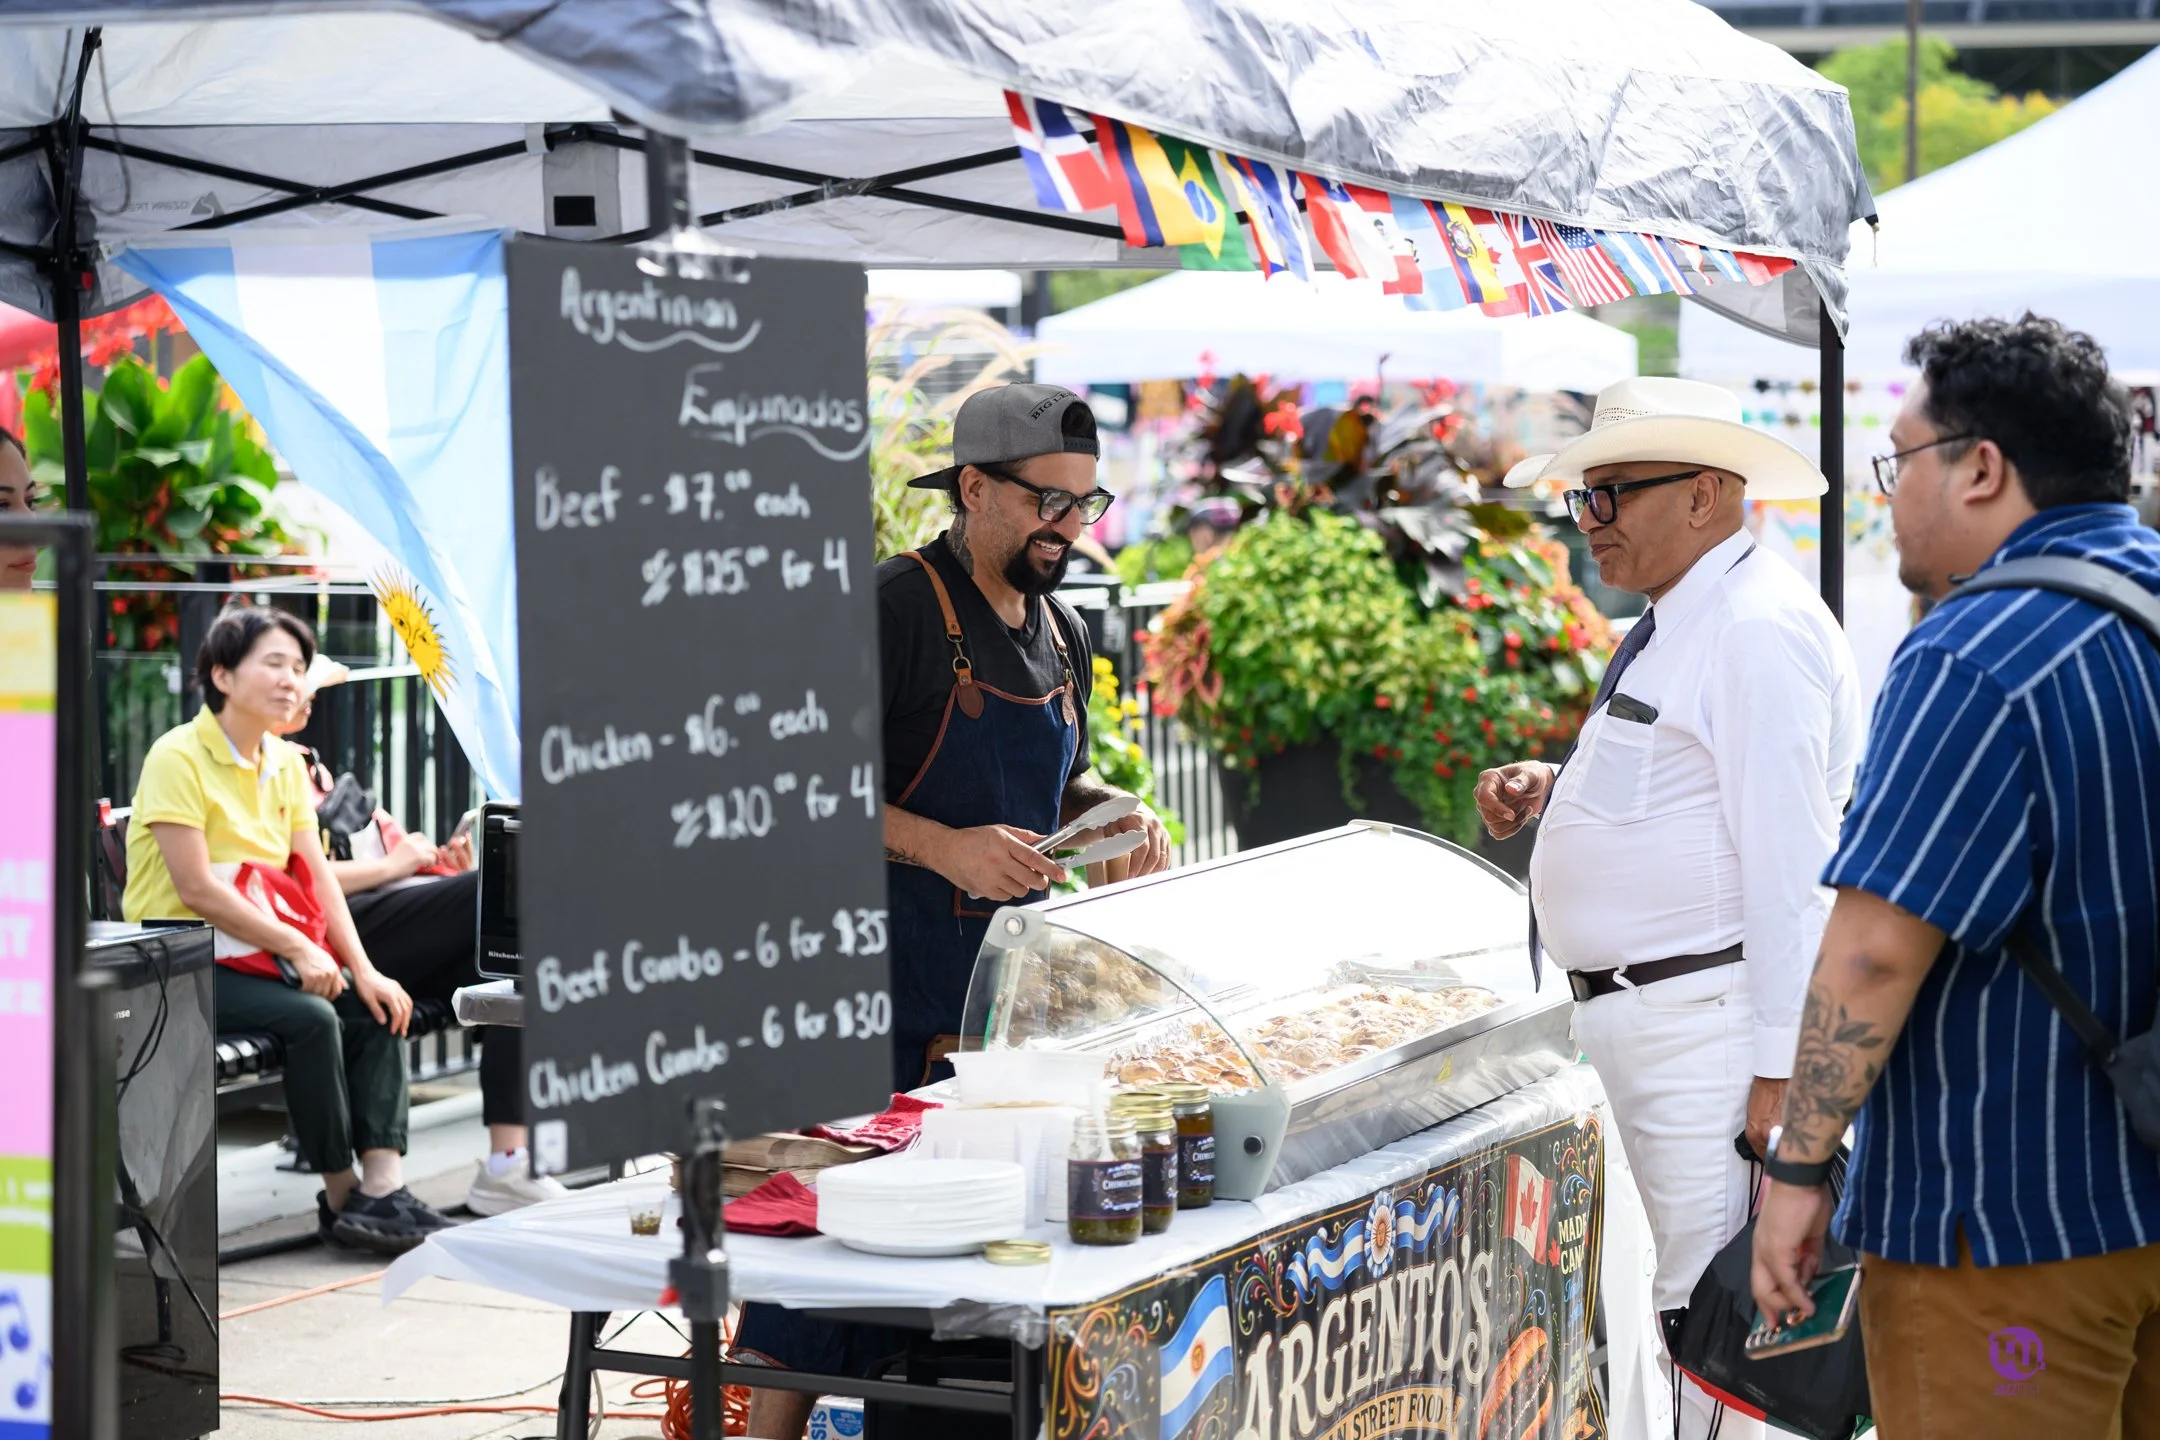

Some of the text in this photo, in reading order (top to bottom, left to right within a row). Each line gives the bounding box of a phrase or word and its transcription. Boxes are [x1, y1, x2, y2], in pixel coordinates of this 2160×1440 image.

[1031, 401, 1053, 421] BIG
[534, 464, 622, 531] Beef
[754, 483, 811, 519] each
[781, 549, 814, 590] for
[823, 537, 850, 594] 4
[540, 725, 653, 785] Chicken
[769, 688, 829, 740] each
[805, 774, 840, 821] for
[850, 762, 876, 819] 4
[536, 949, 611, 1013] Beef
[622, 934, 724, 993] Combo
[755, 920, 780, 968] 6
[789, 915, 826, 961] for
[529, 1053, 639, 1109] Chicken
[645, 1024, 730, 1085] Combo
[761, 1005, 785, 1049] 6
[794, 1001, 829, 1040] for
[833, 990, 892, 1041] $30
[1233, 1233, 1493, 1440] ARGENTO'S
[1353, 1395, 1404, 1440] STREET
[1408, 1393, 1443, 1424] FOOD
